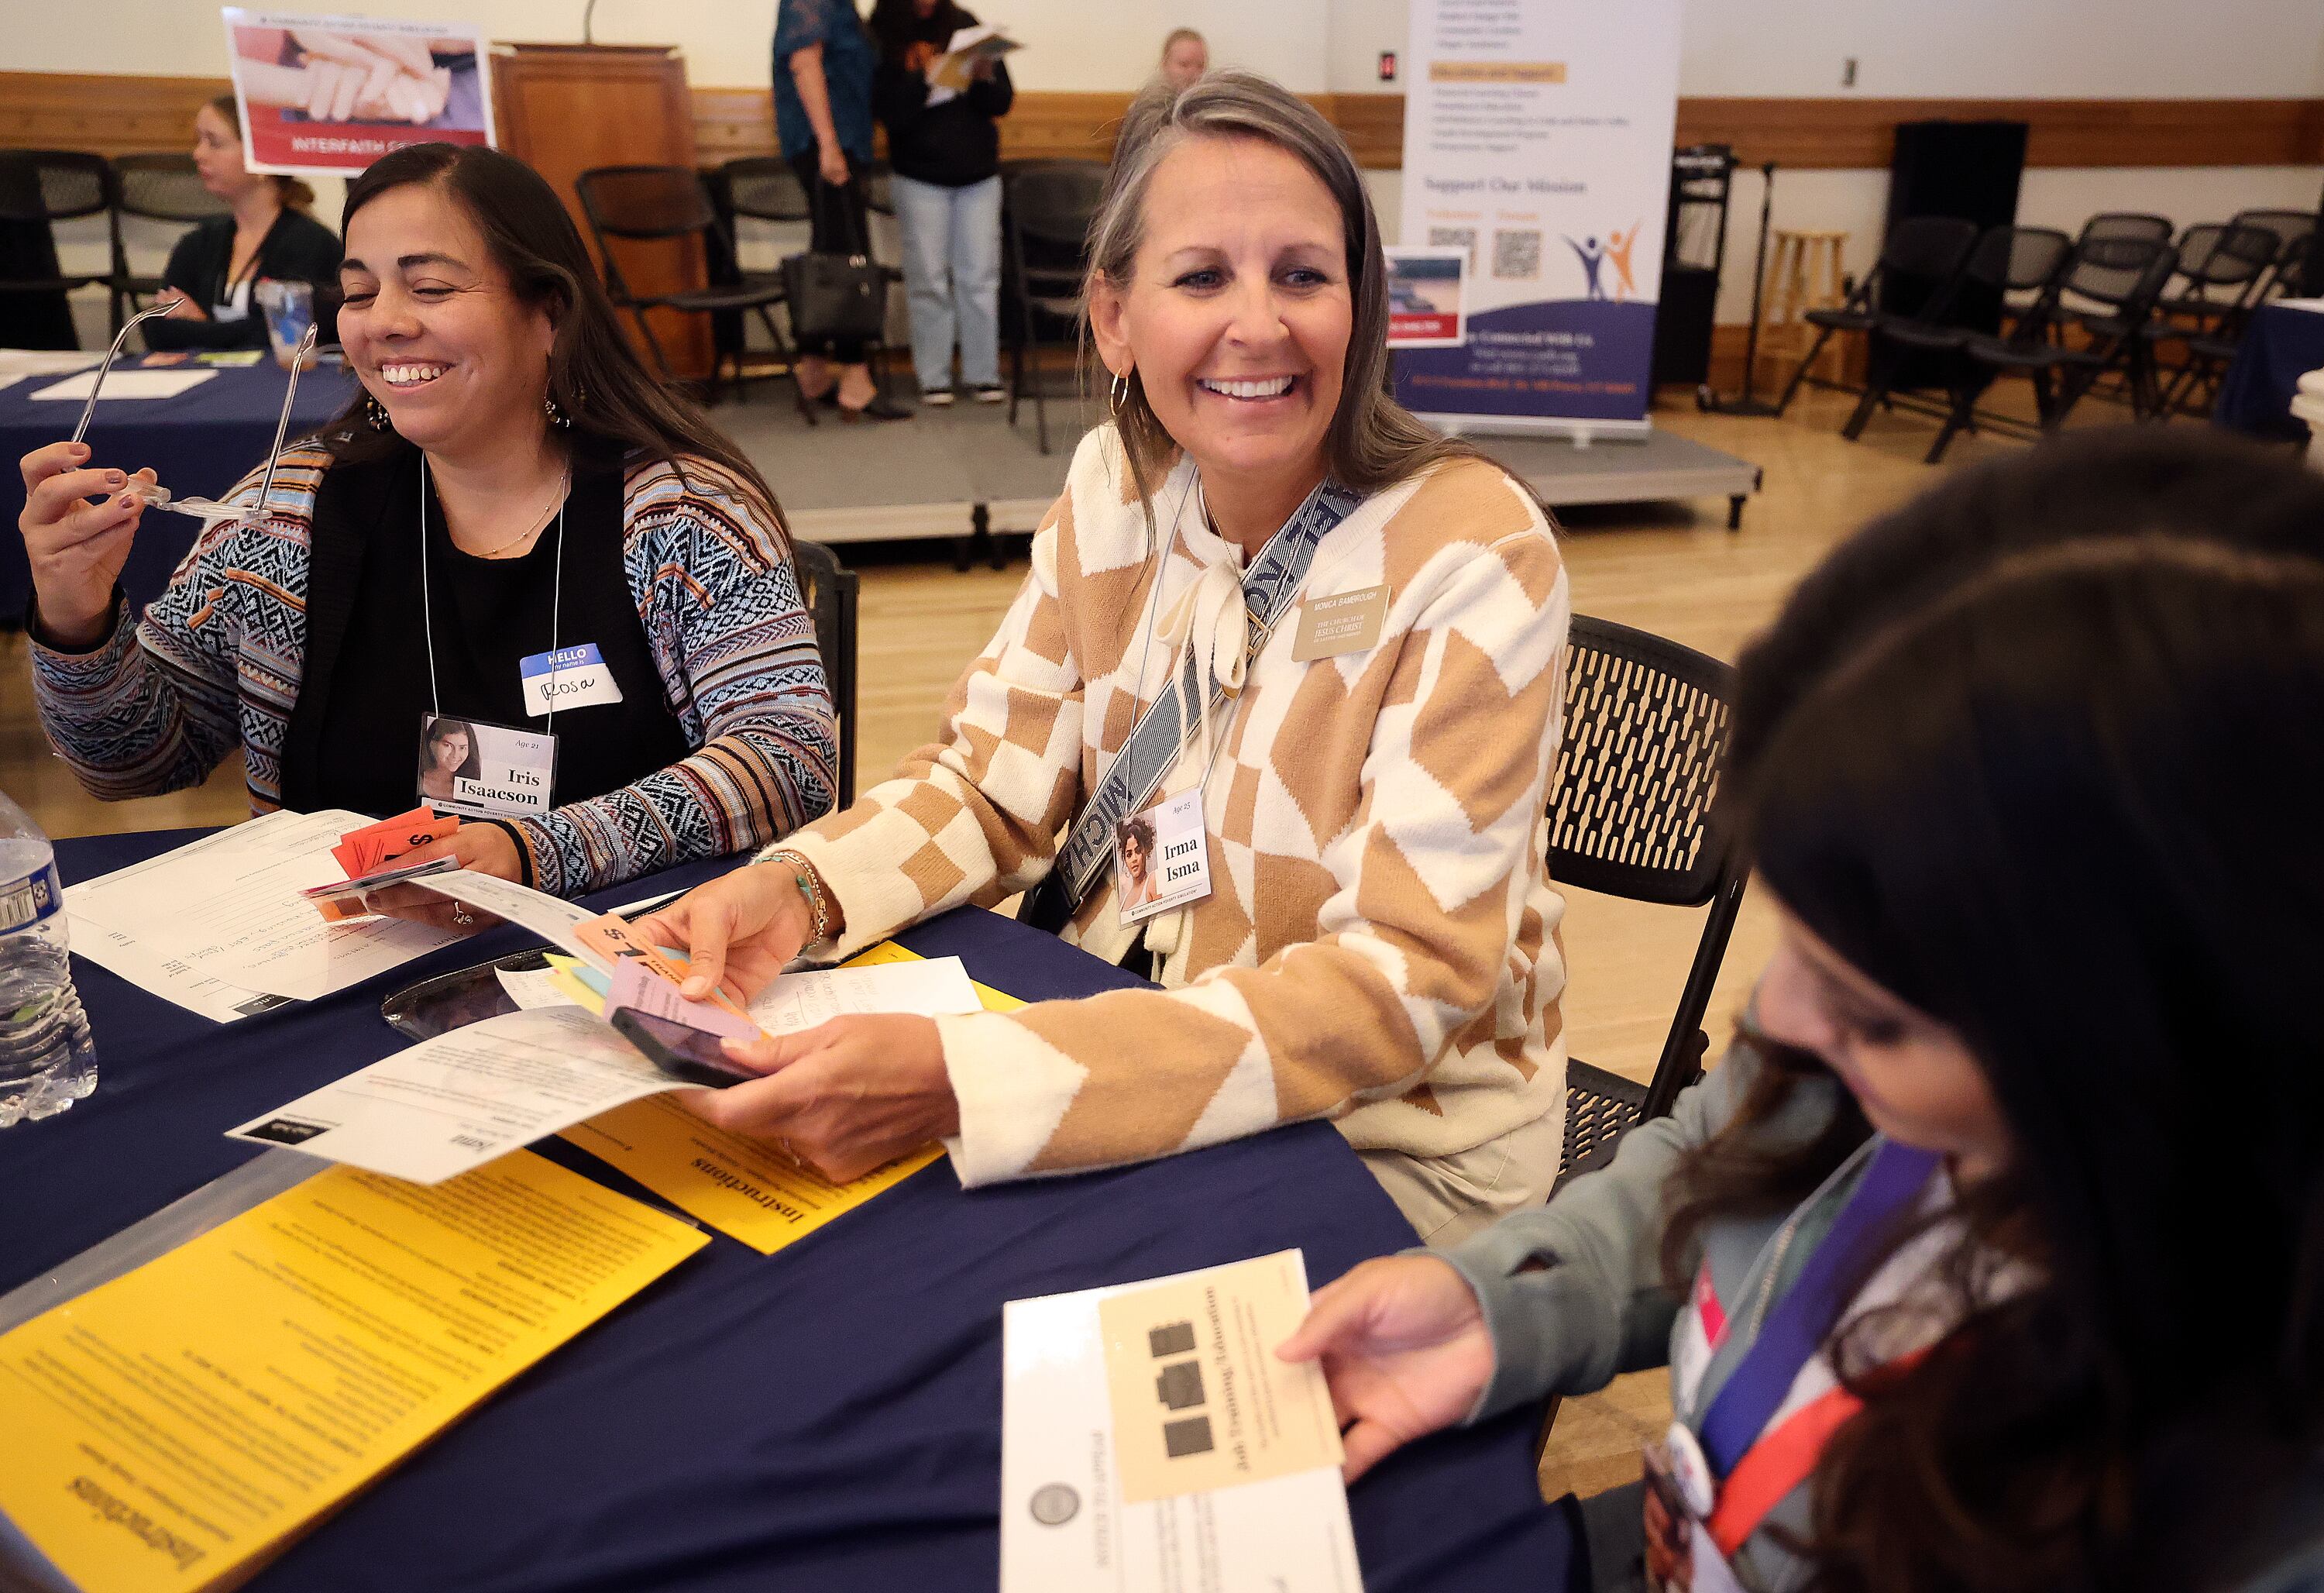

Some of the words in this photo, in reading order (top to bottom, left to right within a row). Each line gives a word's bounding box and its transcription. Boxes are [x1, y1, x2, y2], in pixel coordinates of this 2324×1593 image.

[1314, 600, 1337, 611] MONICA
[1338, 591, 1377, 607] BAMBROUGH
[1315, 628, 1335, 638] JESUS
[1335, 621, 1363, 634] CHRIST
[547, 649, 586, 665] HELLO
[541, 678, 595, 701] Rosa
[515, 738, 530, 749] Age
[507, 769, 540, 786] Iris
[459, 779, 539, 806] Isaacson
[442, 803, 467, 811] COMMUNITY
[1173, 804, 1184, 815] Age
[1164, 838, 1198, 862] Irma
[1166, 860, 1201, 883] Isma
[1135, 904, 1153, 915] COMMUNITY
[691, 1158, 806, 1224] Instructions
